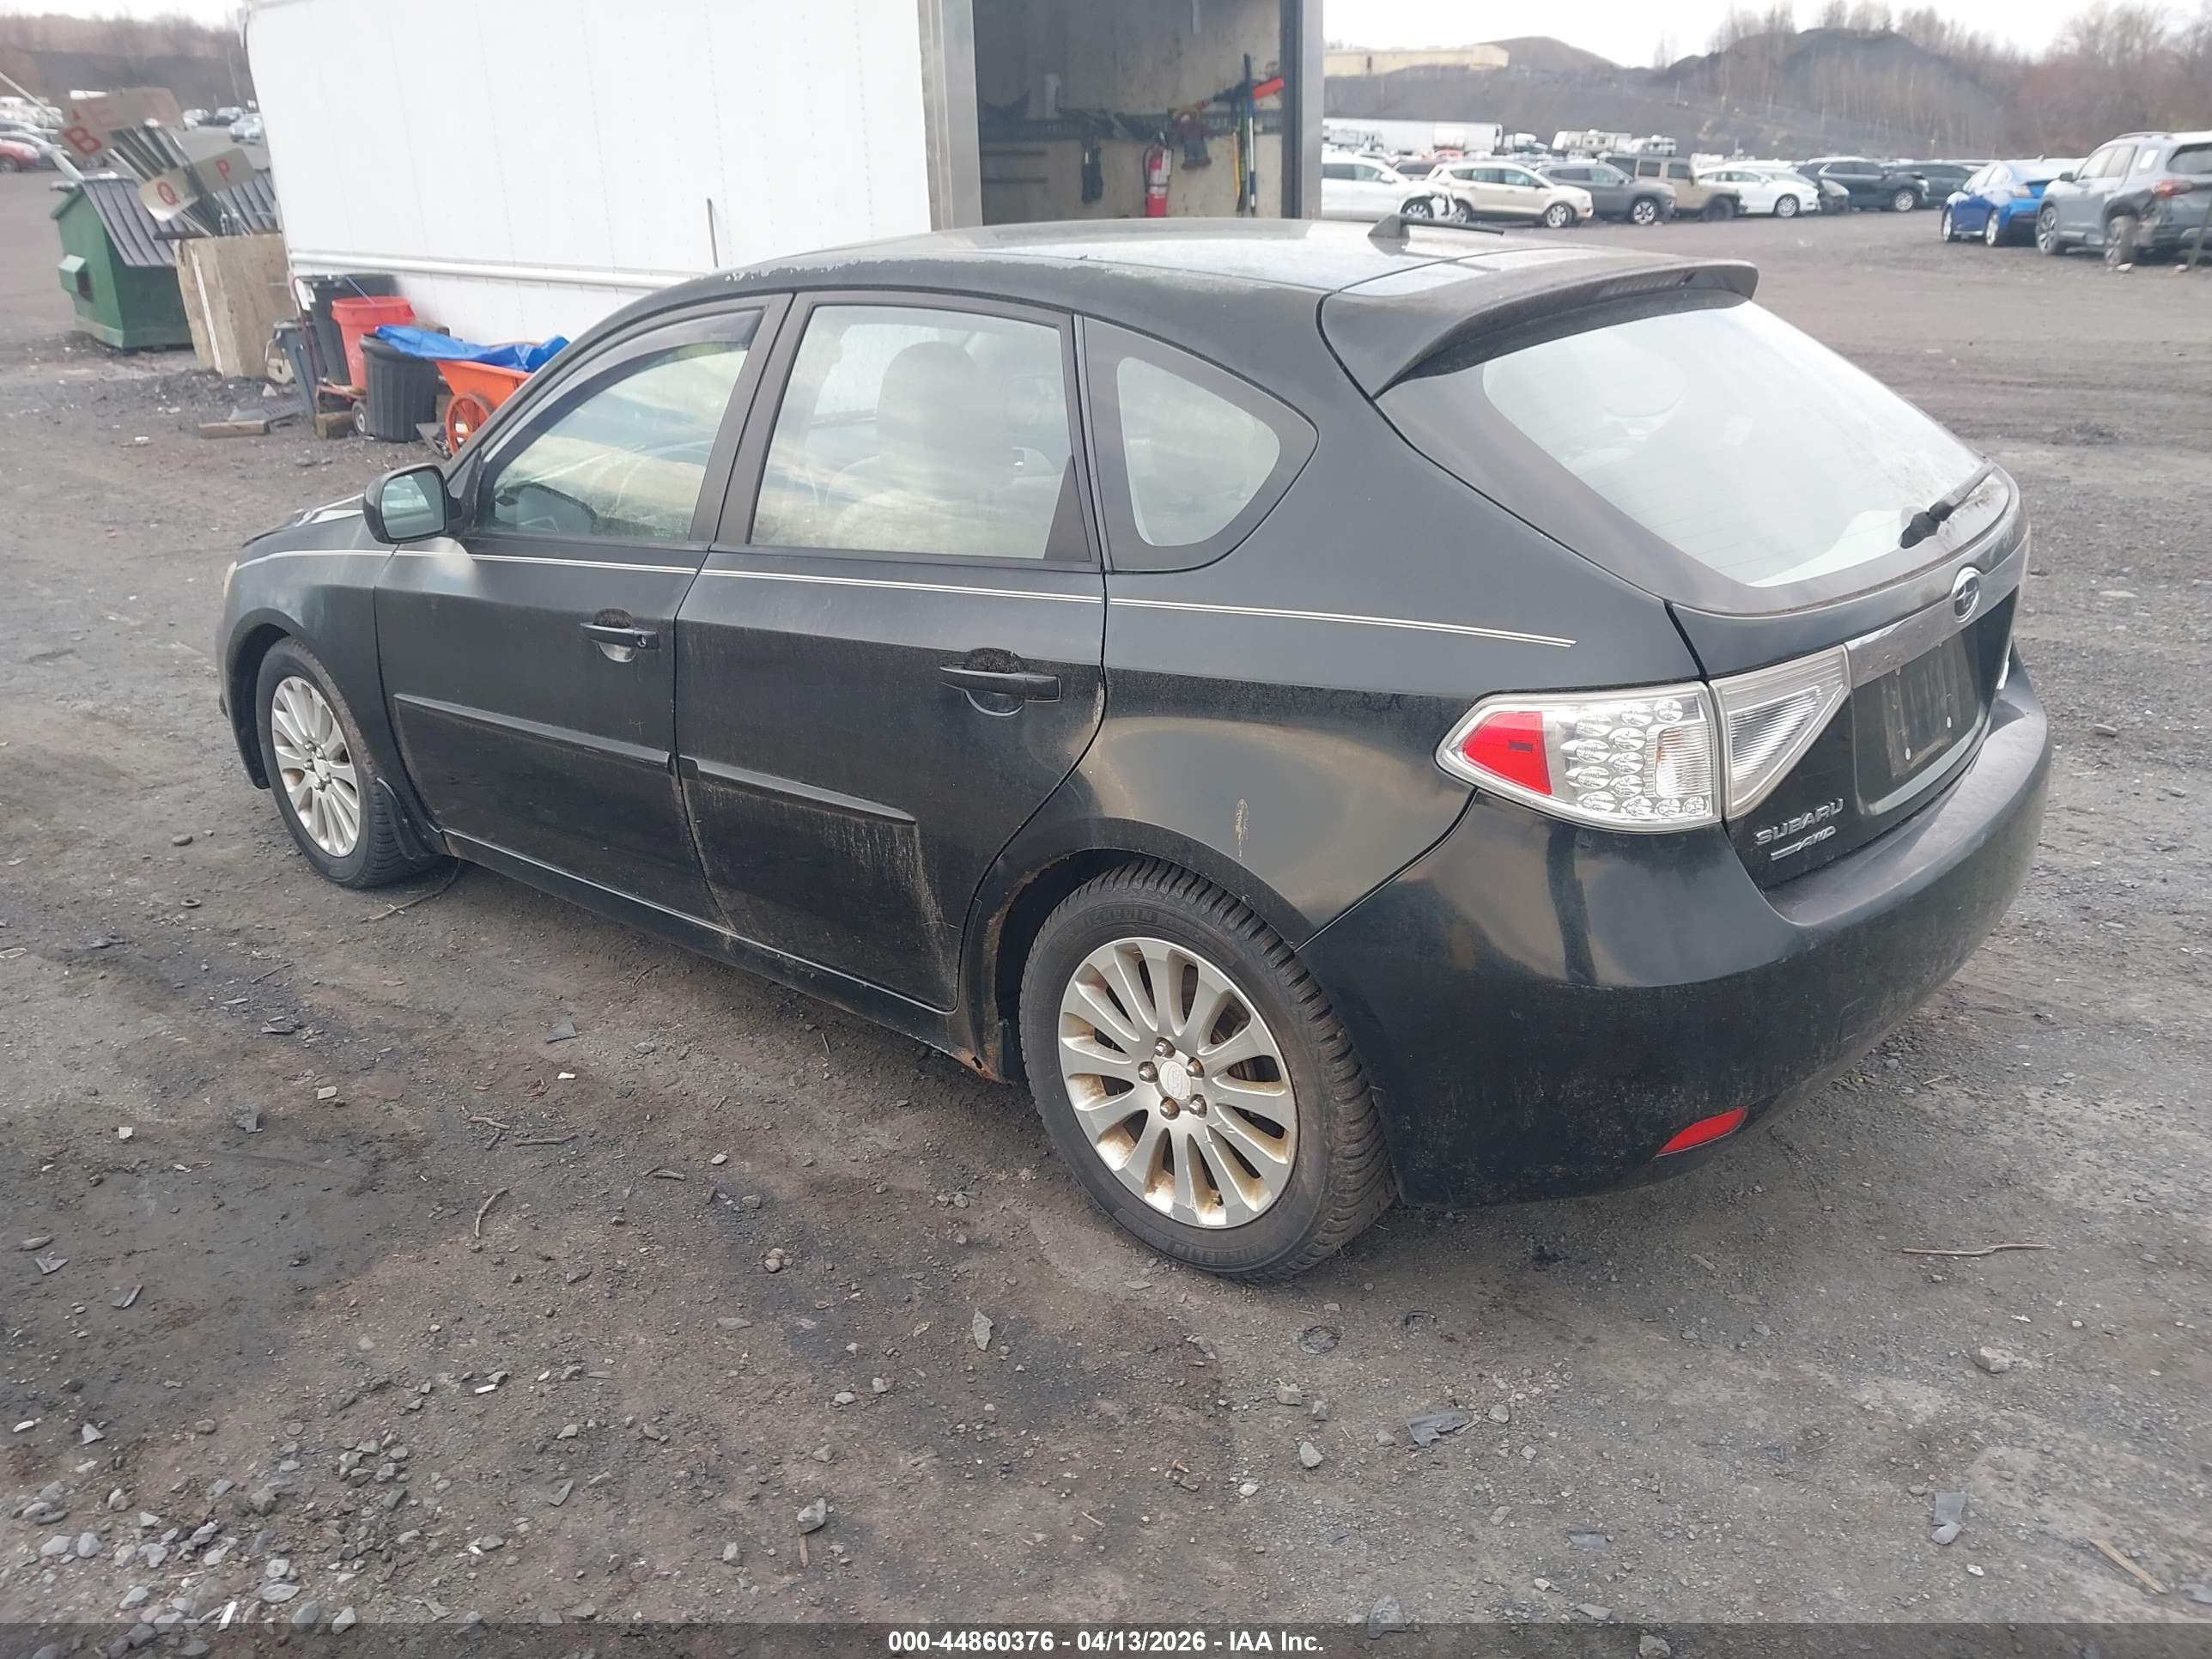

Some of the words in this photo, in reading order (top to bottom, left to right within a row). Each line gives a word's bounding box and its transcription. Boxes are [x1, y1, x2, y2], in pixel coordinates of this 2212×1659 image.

[64, 126, 101, 155] B
[216, 159, 231, 182] P
[157, 181, 179, 205] Q
[1753, 798, 1844, 846] SUBARU
[1792, 825, 1837, 854] AWD
